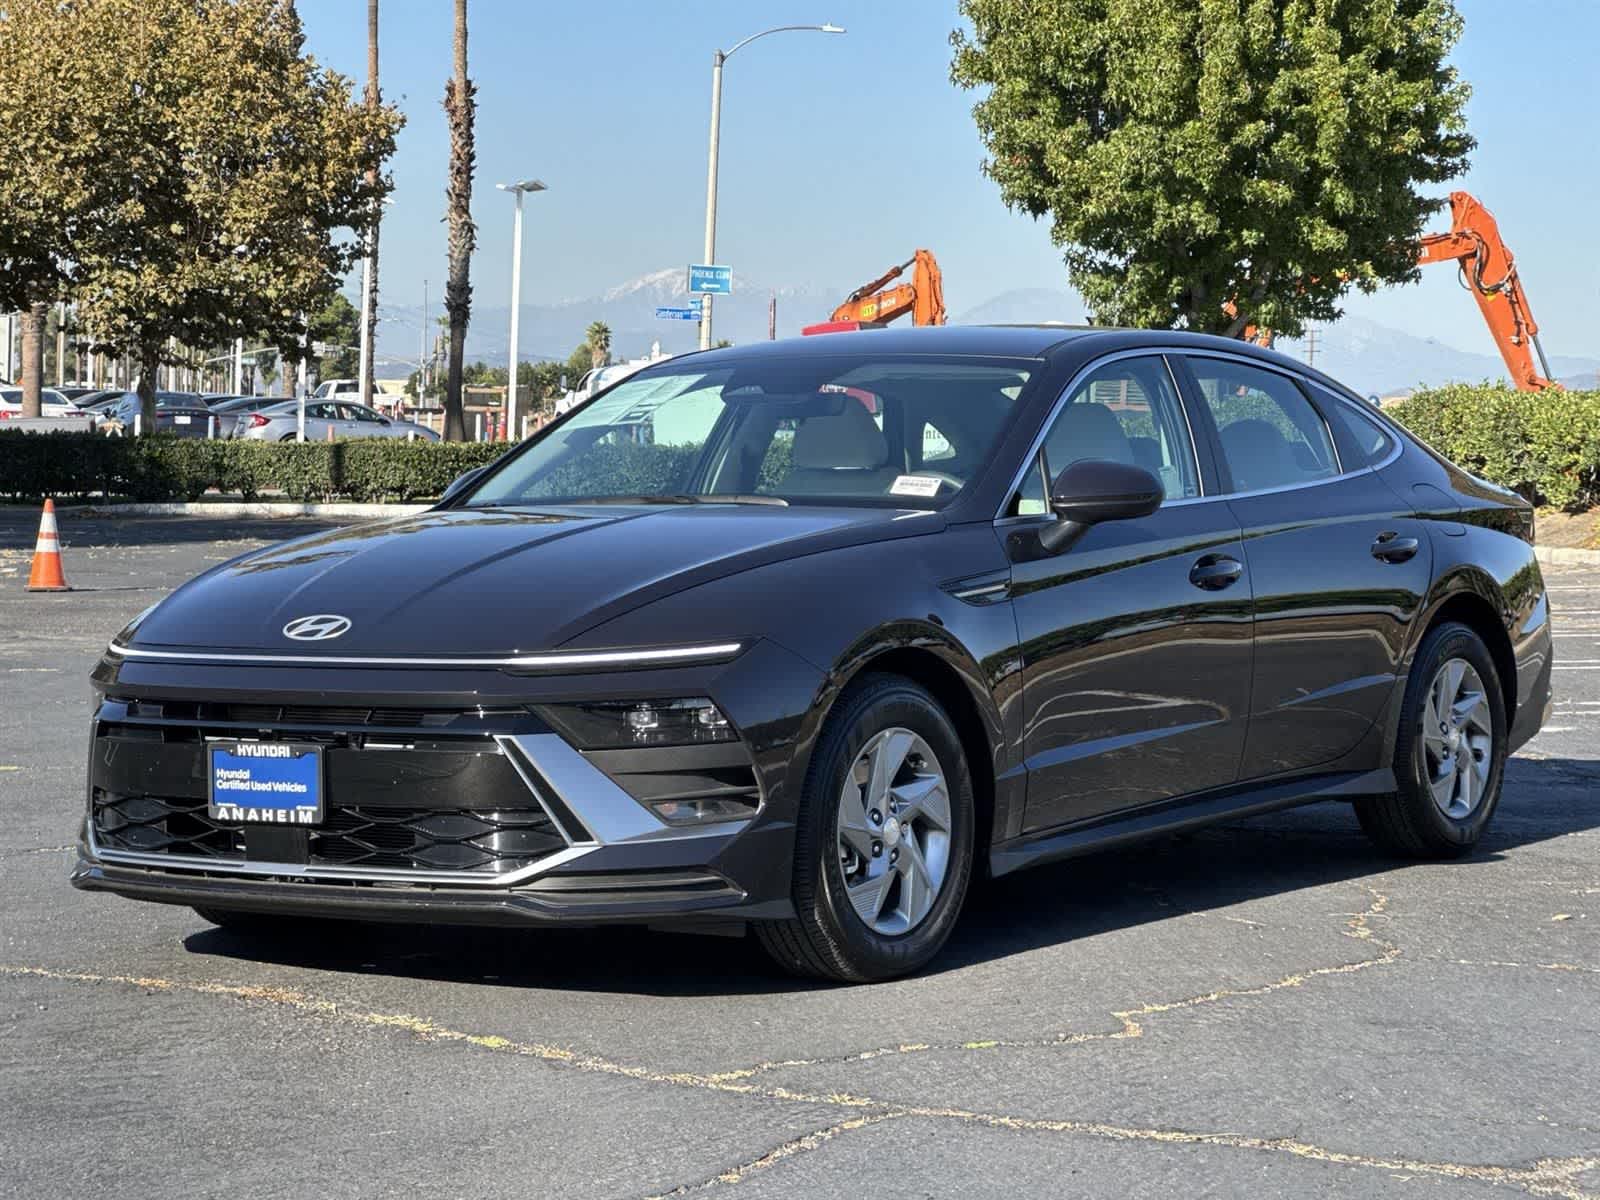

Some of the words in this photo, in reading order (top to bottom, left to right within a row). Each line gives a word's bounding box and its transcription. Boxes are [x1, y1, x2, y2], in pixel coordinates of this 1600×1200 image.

[237, 744, 290, 758] HYUNDAI
[216, 769, 250, 780] Hyundai
[216, 780, 250, 791] Certified
[251, 782, 272, 792] Used
[272, 782, 307, 793] Vehicles
[217, 807, 313, 823] ANAHEIM
